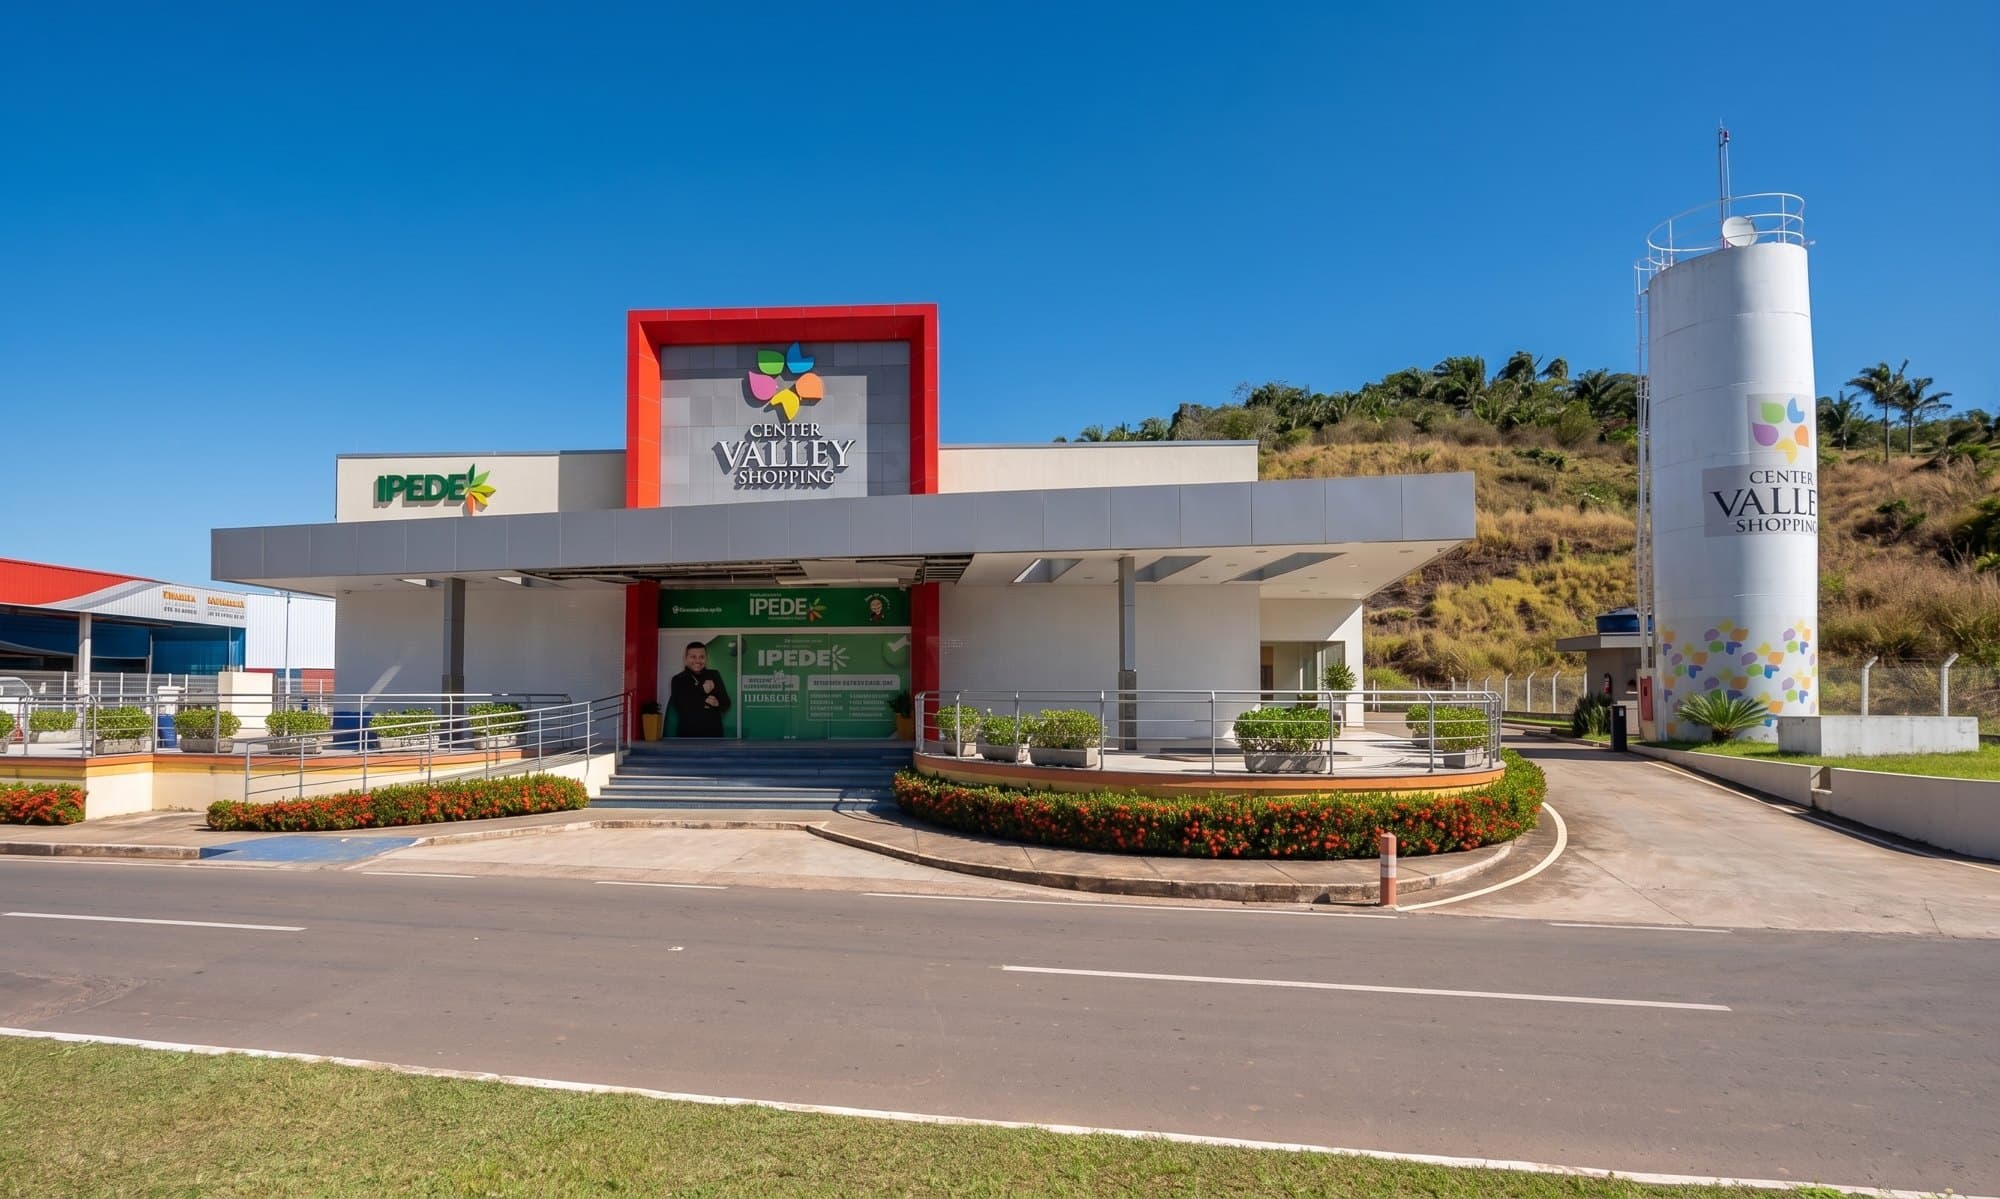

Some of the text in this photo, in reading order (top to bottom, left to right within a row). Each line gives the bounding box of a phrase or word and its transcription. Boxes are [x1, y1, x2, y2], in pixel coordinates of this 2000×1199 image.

[750, 423, 822, 437] CENTER
[719, 439, 856, 468] VALLEY
[739, 469, 835, 484] SHOPPING
[1749, 470, 1813, 485] CENTER
[377, 473, 467, 502] IPEDE
[1709, 487, 1816, 518] VALLE
[750, 598, 808, 616] IPEDE
[758, 649, 831, 667] IPEDE
